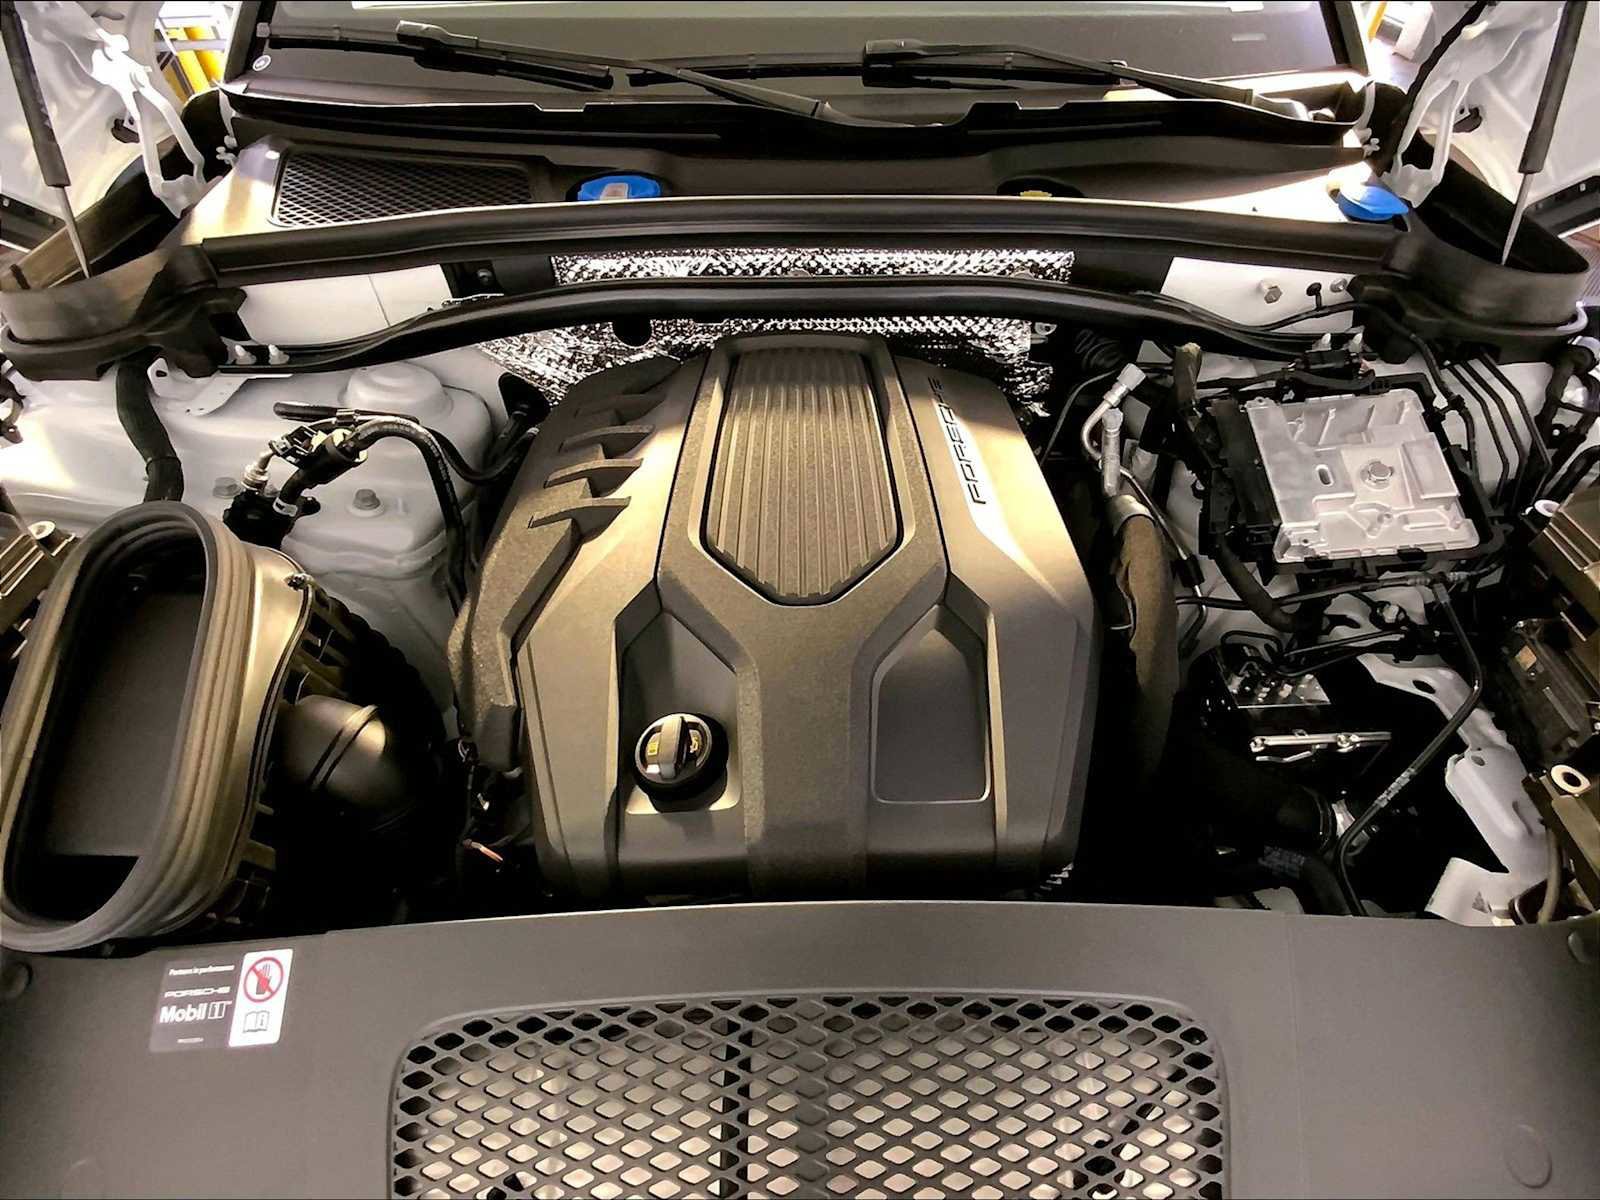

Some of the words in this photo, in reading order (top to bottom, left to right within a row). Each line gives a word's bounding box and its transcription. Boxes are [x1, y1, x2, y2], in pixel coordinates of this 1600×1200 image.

[928, 376, 987, 504] PORSCHE
[164, 986, 231, 998] PORSCHE
[159, 1003, 208, 1023] Mobil
